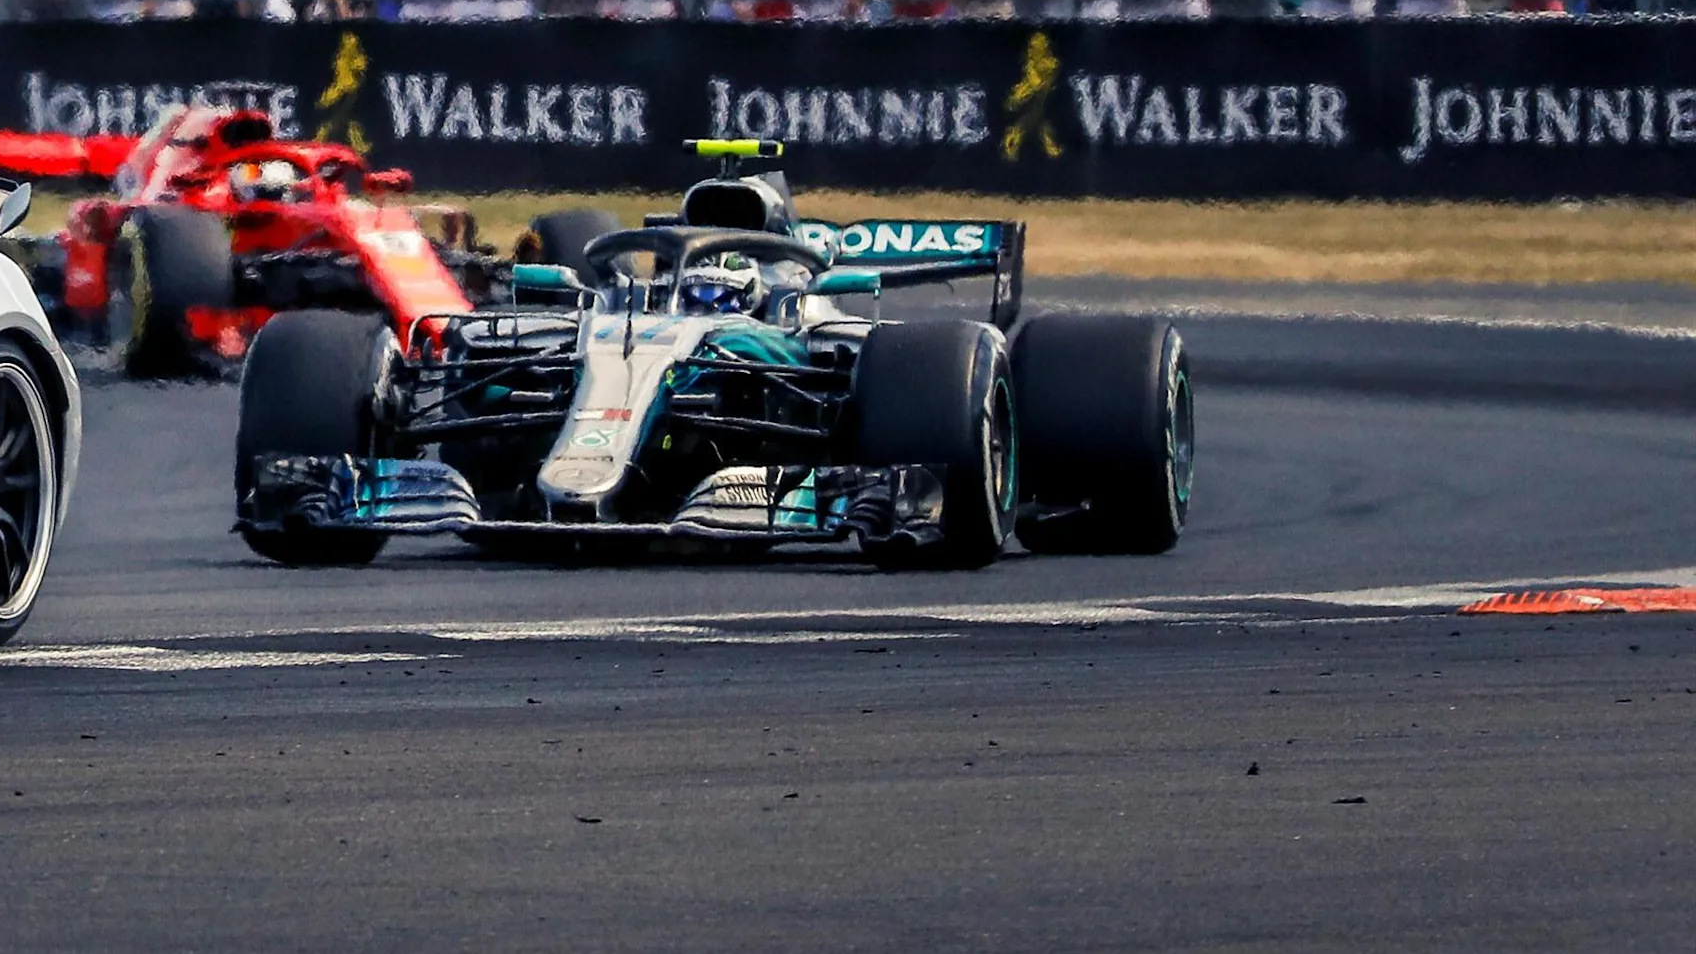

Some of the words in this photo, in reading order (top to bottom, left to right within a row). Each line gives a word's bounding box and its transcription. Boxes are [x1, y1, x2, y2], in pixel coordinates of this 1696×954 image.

[383, 72, 649, 145] WALKER
[708, 75, 989, 145] JOHNNIE
[1067, 71, 1348, 144] WALKER
[1399, 75, 1696, 163] JOHNNIE
[800, 222, 985, 257] RONAS
[719, 473, 765, 483] PETRON
